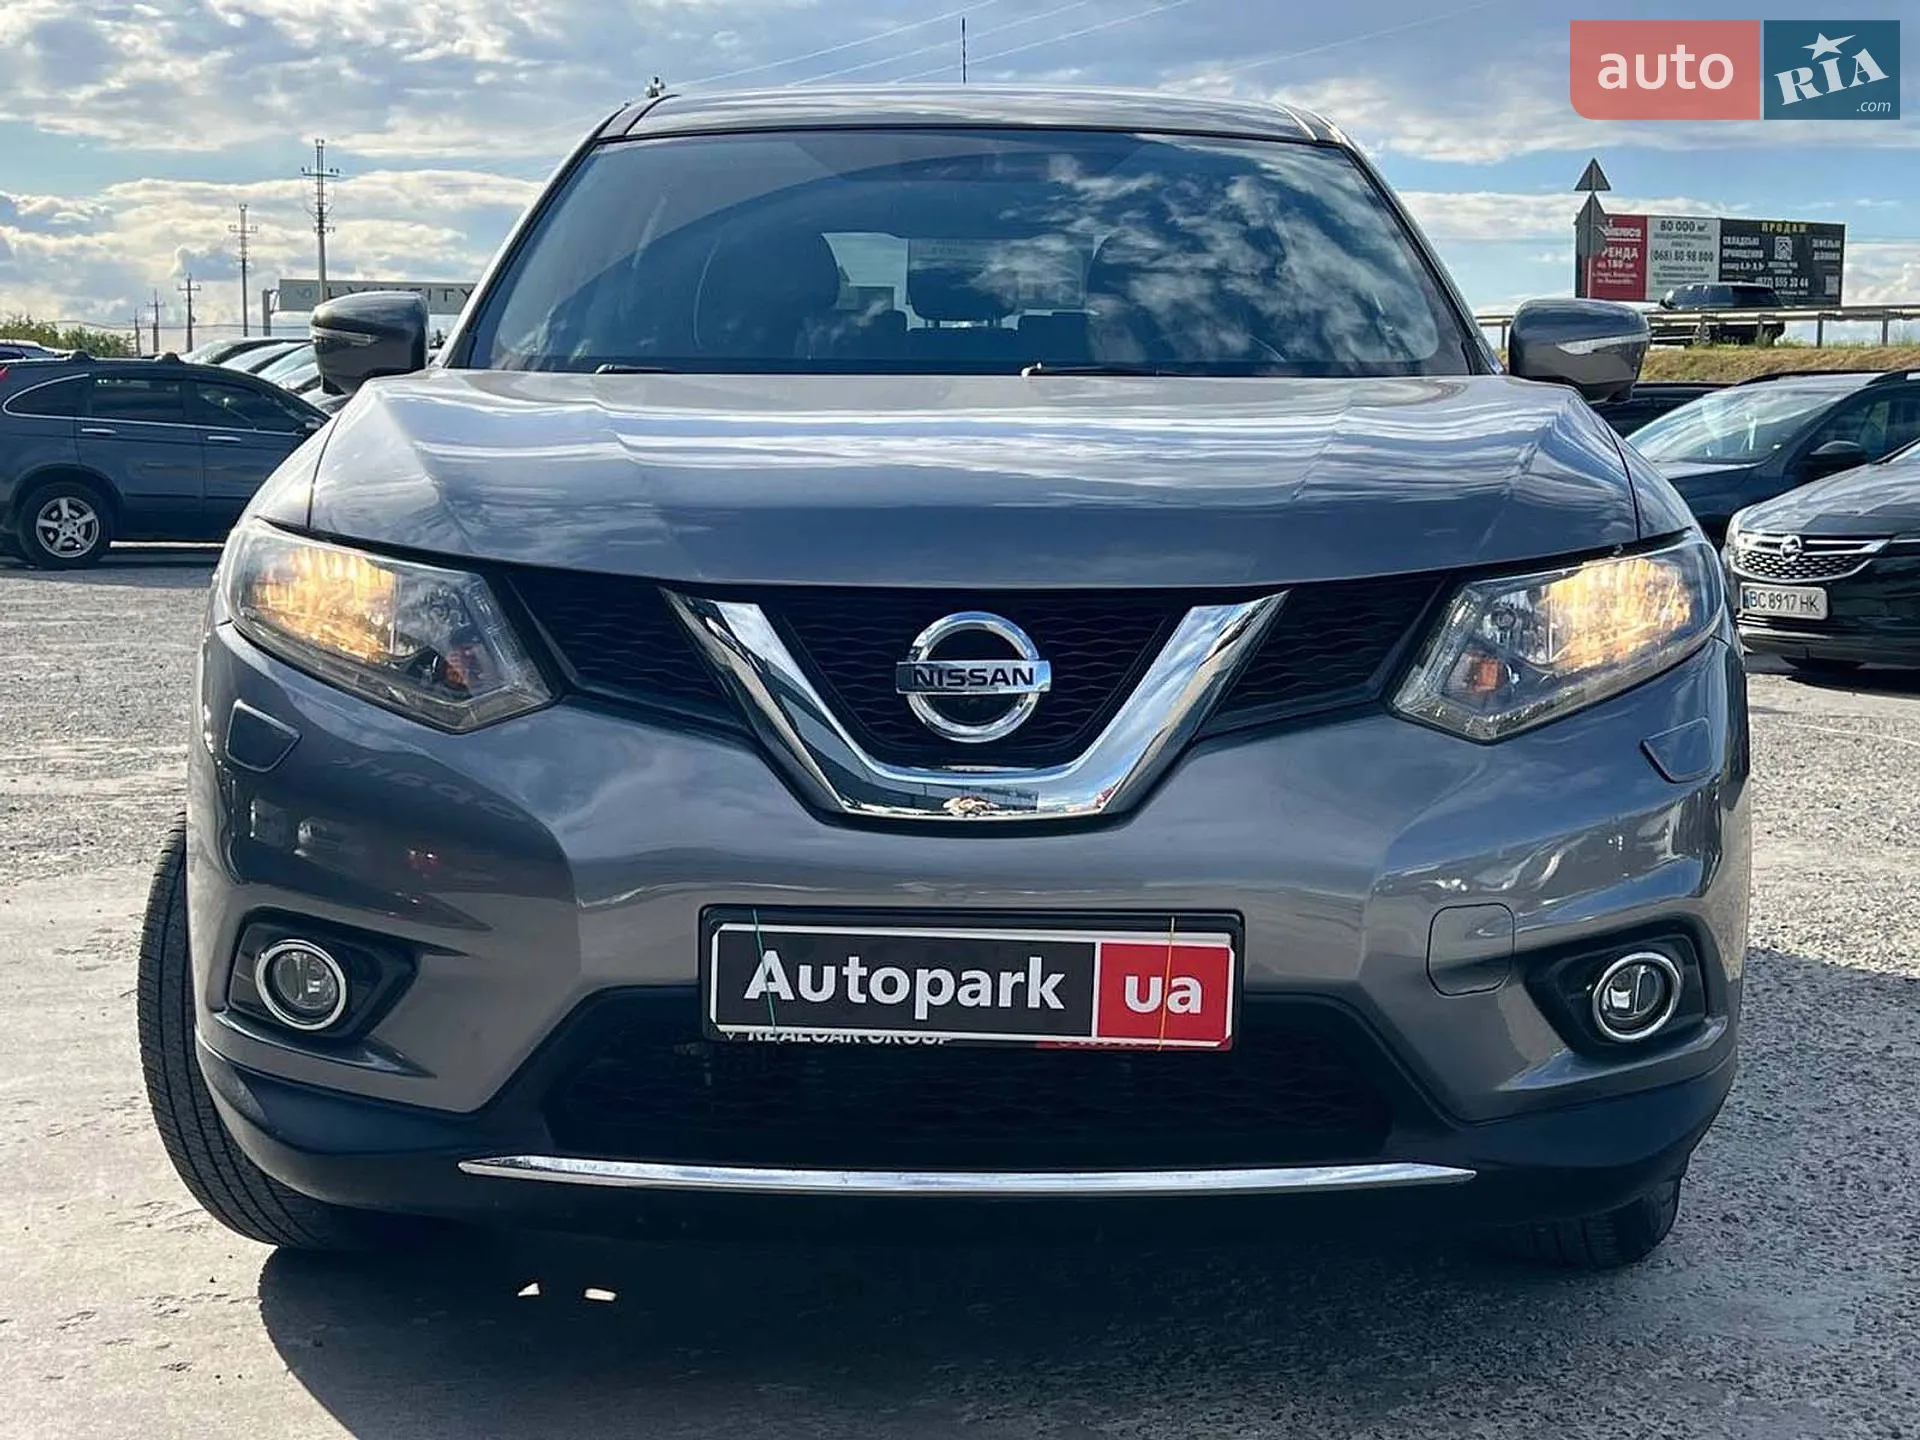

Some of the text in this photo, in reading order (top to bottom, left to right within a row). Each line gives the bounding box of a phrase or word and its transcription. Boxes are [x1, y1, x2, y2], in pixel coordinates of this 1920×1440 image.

[1749, 591, 1820, 612] BC 8917 HK
[914, 667, 1034, 687] NISSAN
[744, 950, 1202, 1021] Autopark ua
